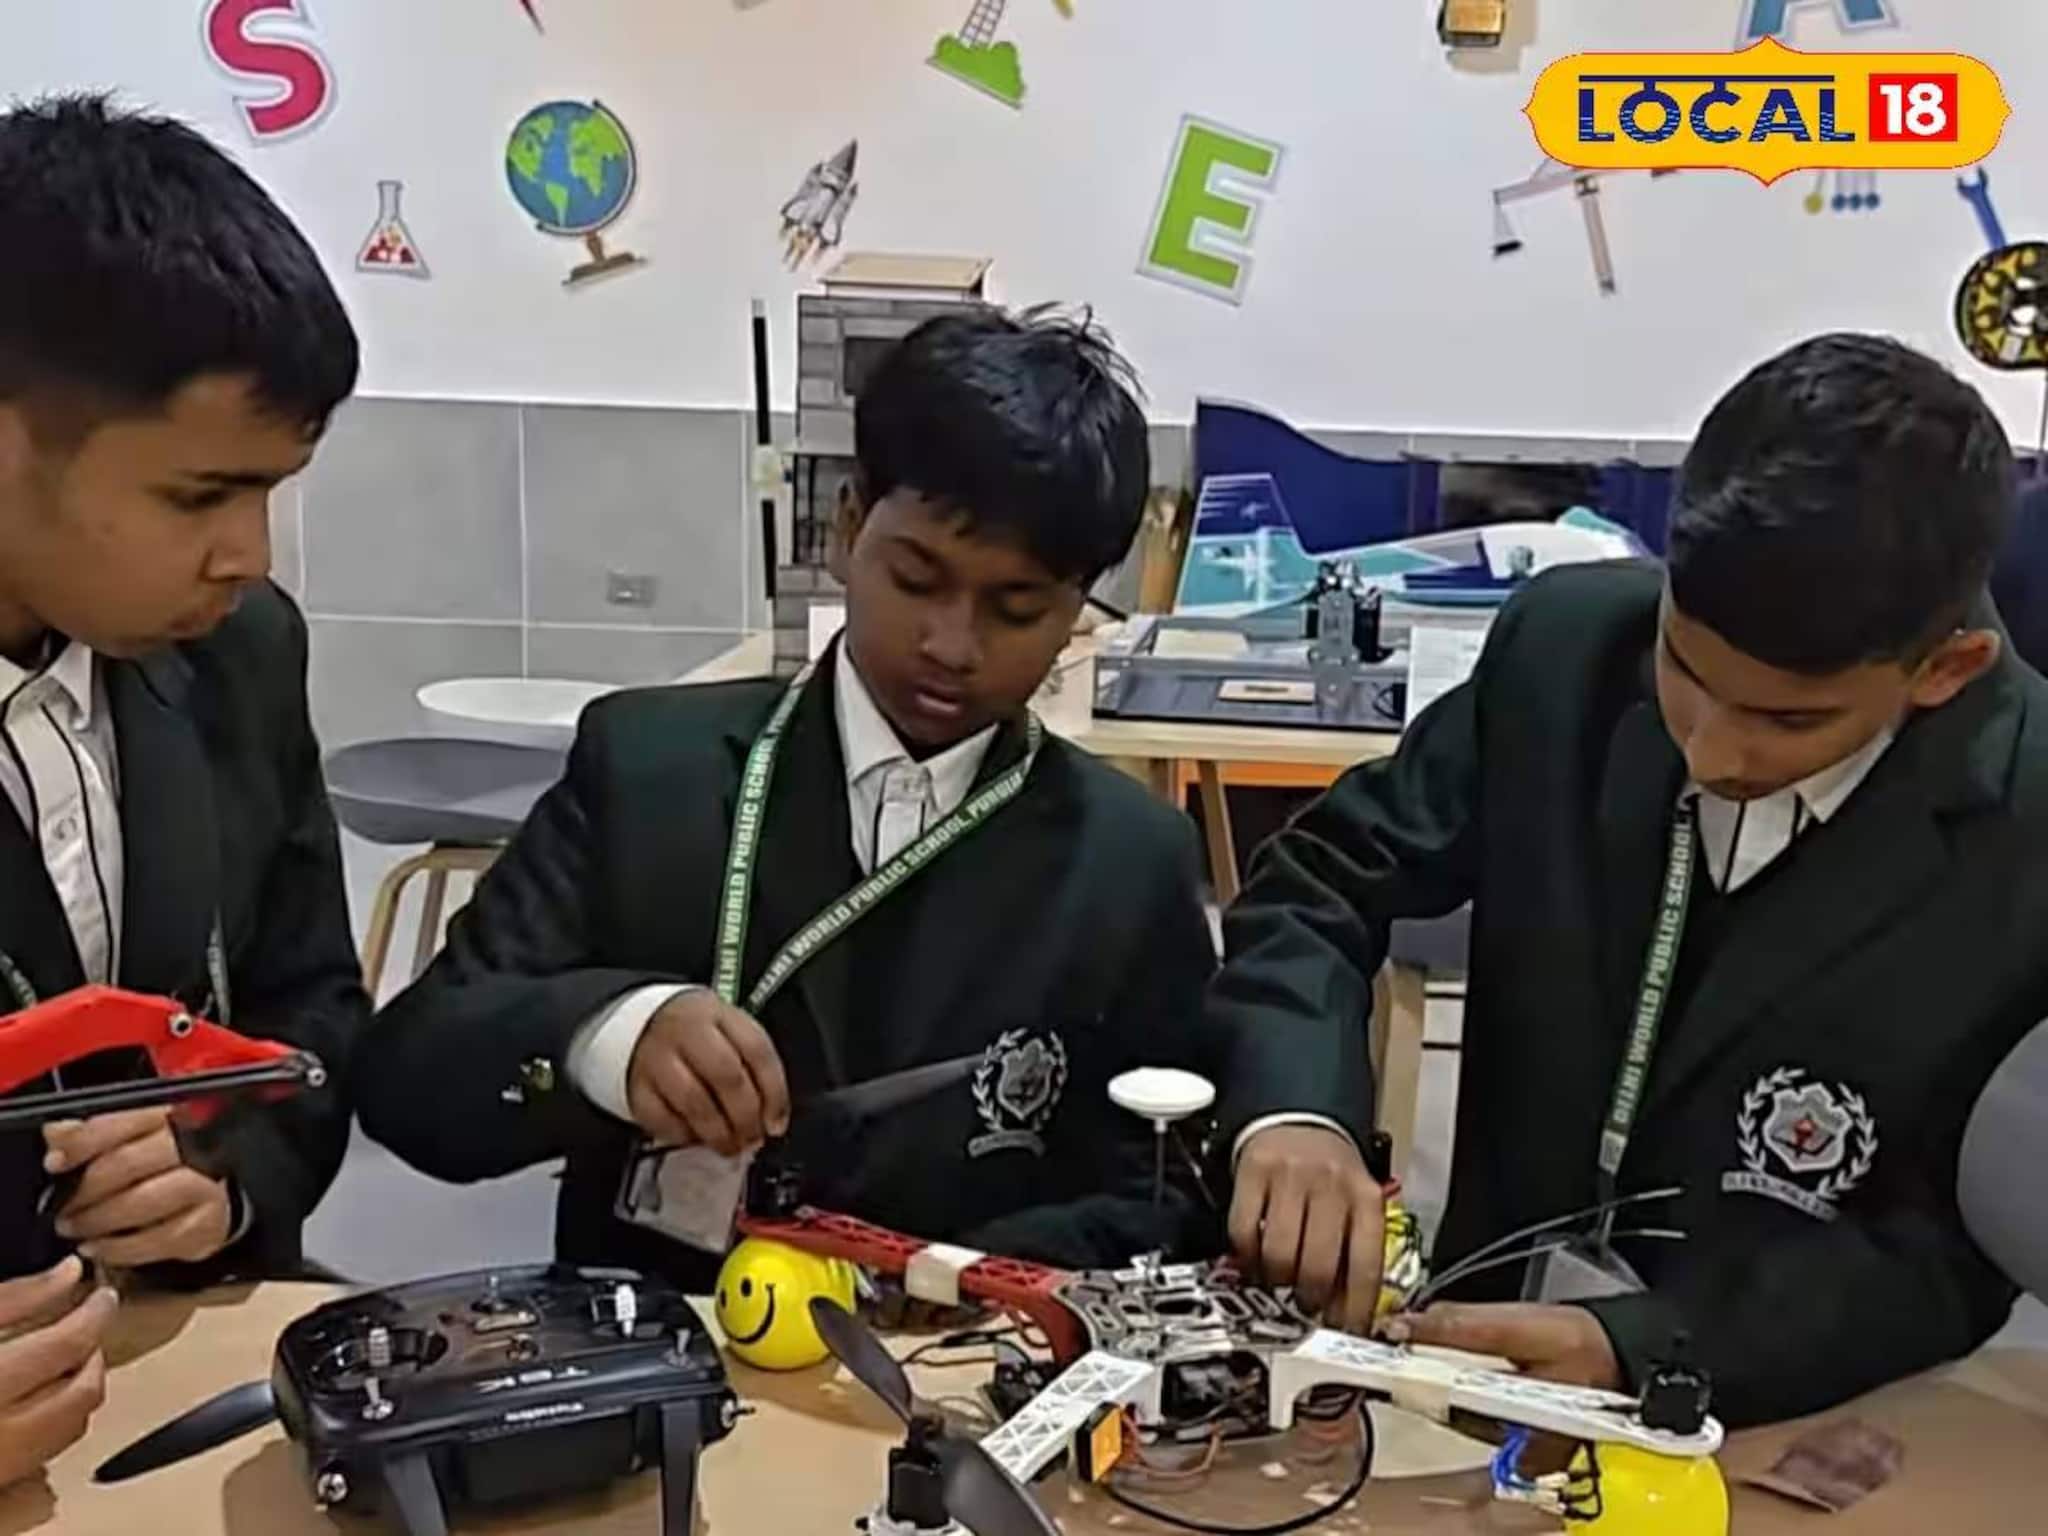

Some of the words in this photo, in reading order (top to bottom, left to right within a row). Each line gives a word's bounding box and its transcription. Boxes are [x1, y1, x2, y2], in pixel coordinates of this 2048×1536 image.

[206, 0, 329, 136] S
[1144, 120, 1278, 295] E
[734, 802, 758, 868] PUBLIC
[725, 874, 746, 943] WORLD
[793, 907, 851, 957] WORLD
[849, 862, 908, 911] PUBLIC
[1628, 988, 1660, 1064] WORLD
[1647, 911, 1680, 986] PUBLIC
